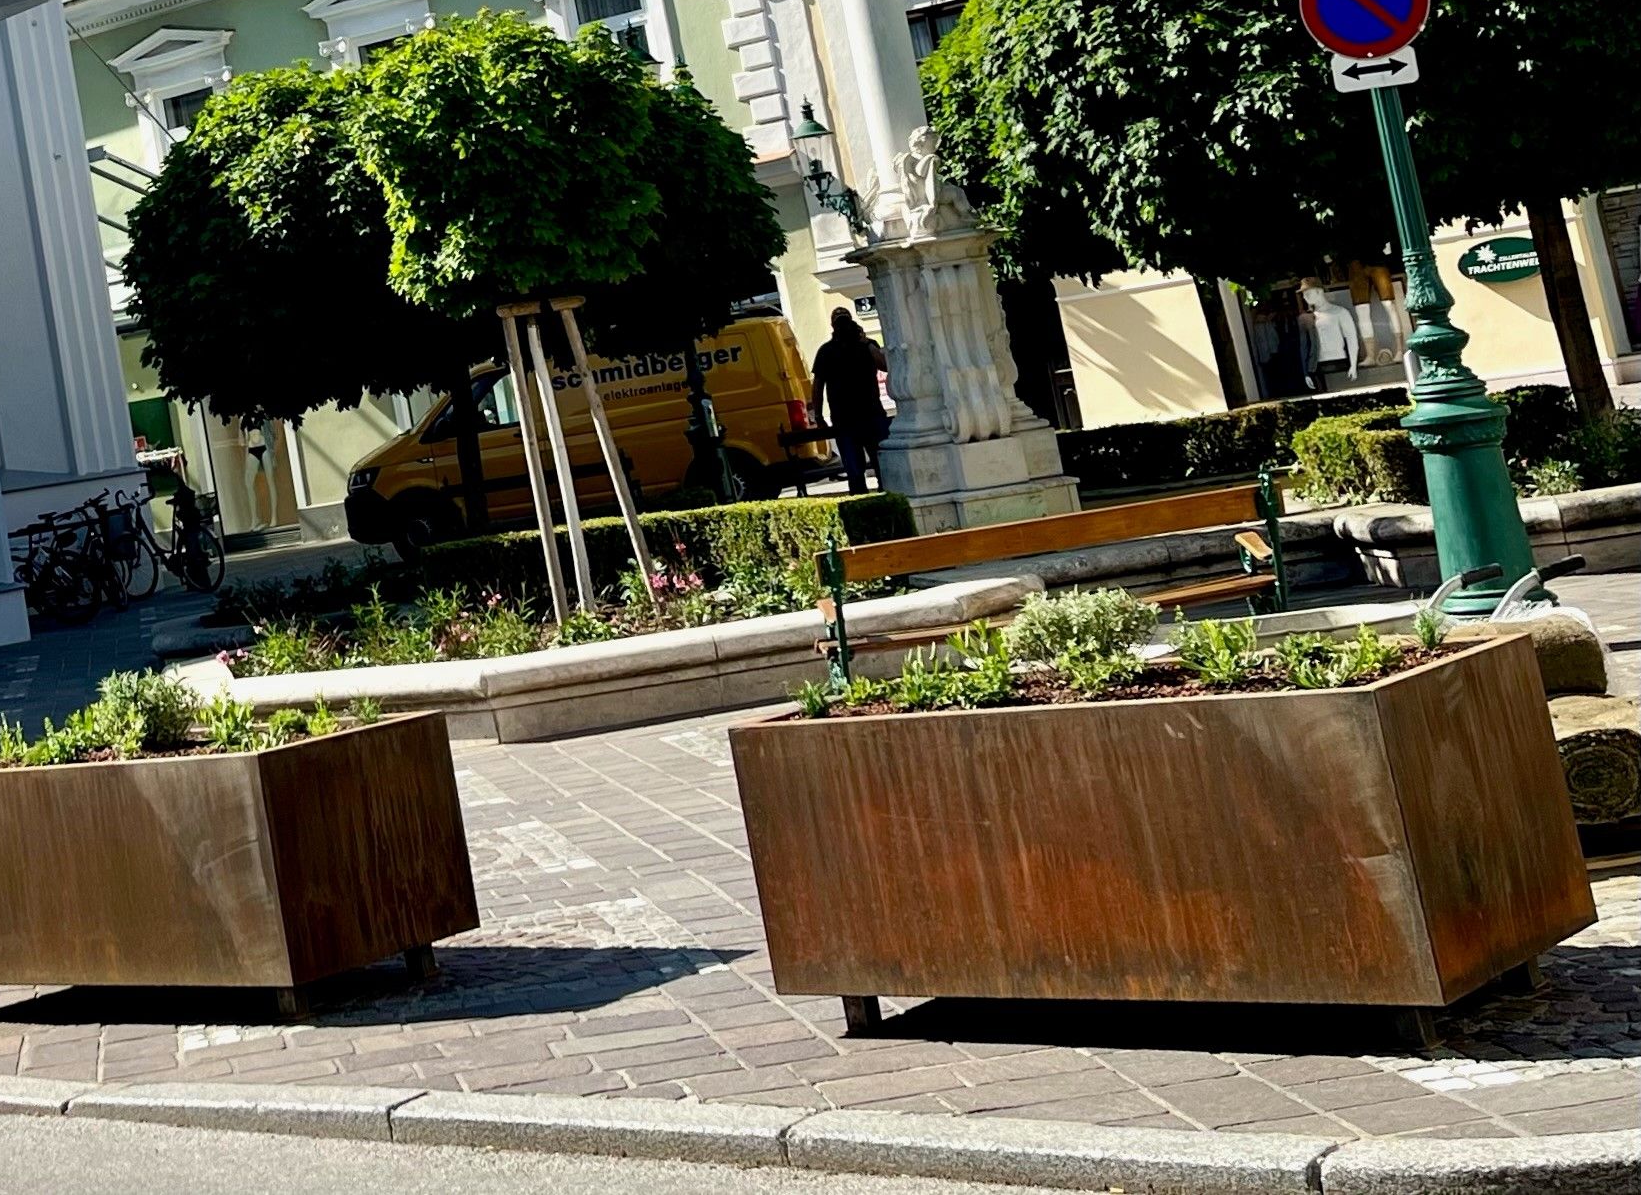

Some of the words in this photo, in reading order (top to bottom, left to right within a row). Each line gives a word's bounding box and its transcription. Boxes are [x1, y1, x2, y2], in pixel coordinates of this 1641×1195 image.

[1467, 257, 1540, 275] TRACHTENWEL
[861, 297, 871, 312] 3
[551, 345, 742, 392] scmidbeger
[603, 380, 692, 402] elektroanlage
